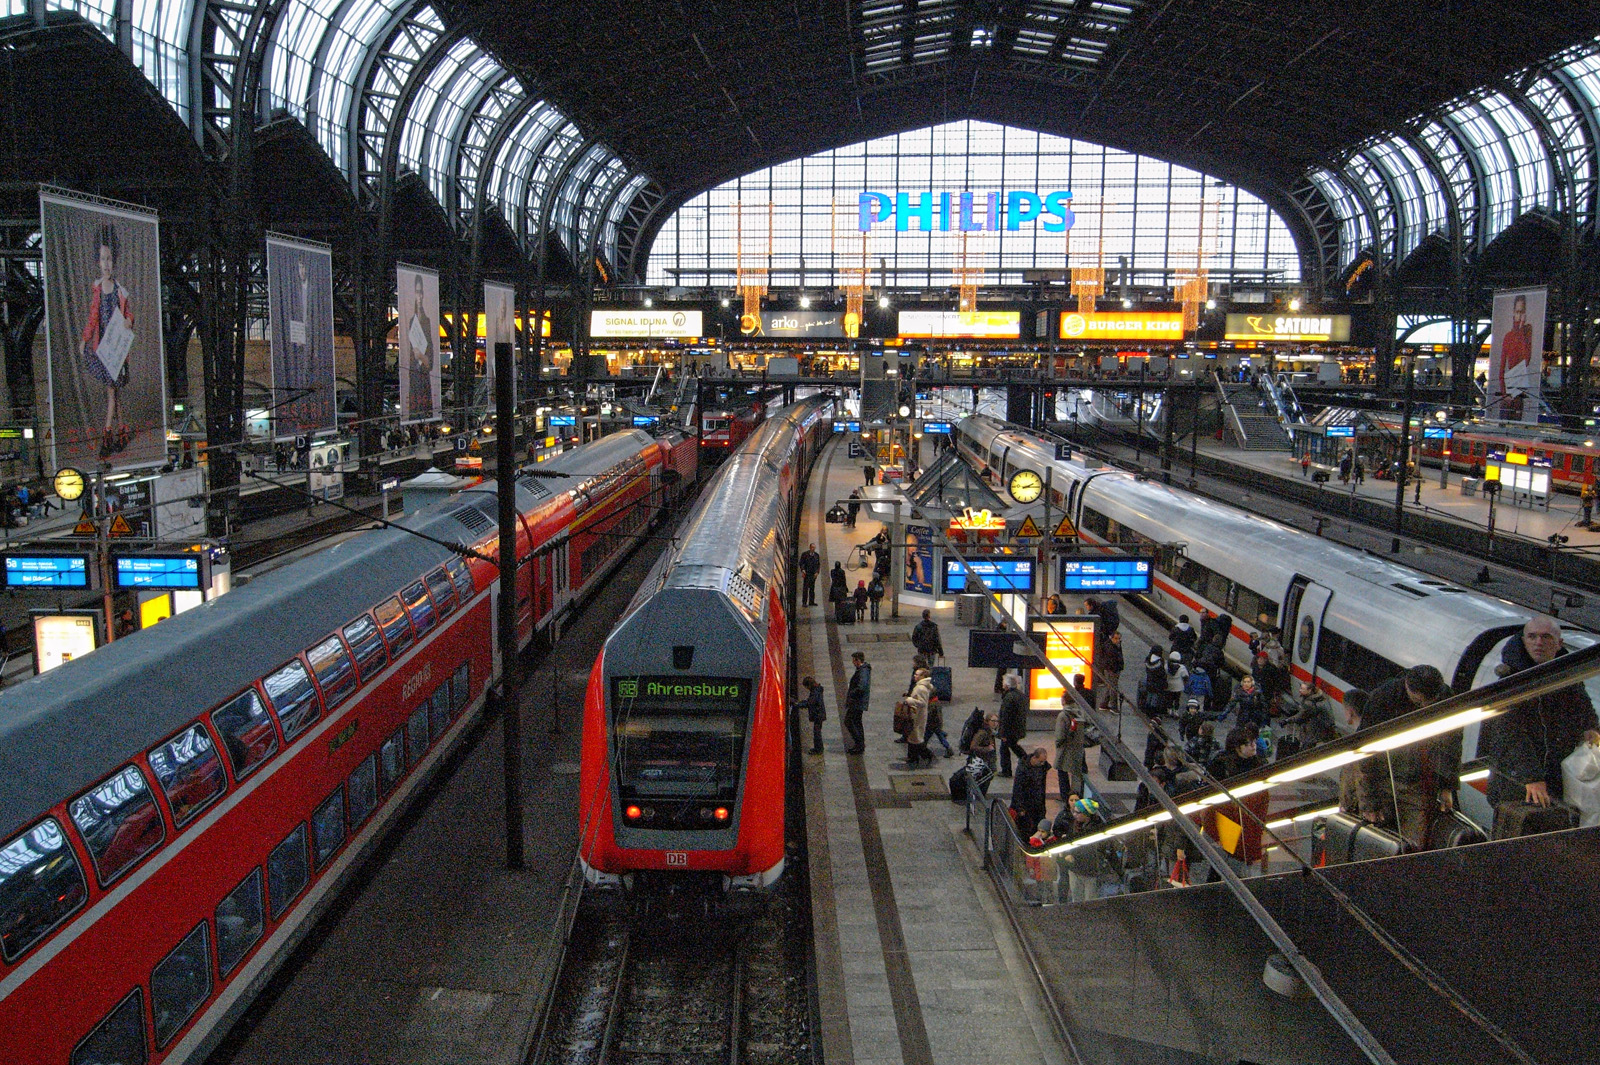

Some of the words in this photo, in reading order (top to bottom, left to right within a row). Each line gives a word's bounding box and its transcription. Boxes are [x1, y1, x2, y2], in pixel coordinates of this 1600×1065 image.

[858, 190, 1075, 232] PHILIPS
[605, 318, 638, 326] SIGNAL
[640, 318, 667, 326] IDUNA
[771, 315, 798, 329] arko
[1088, 320, 1142, 331] BURGER
[1146, 321, 1180, 331] KING
[1274, 317, 1332, 335] SATURN
[297, 437, 306, 449] D
[458, 438, 467, 450] D
[850, 443, 859, 456] E
[1062, 445, 1070, 458] E
[960, 519, 998, 528] KIOSK
[6, 556, 17, 568] 5a
[186, 559, 198, 569] 6a
[947, 561, 959, 571] 7a
[1136, 561, 1148, 572] 8a
[647, 682, 739, 698] Ahrensburg
[668, 853, 686, 864] DB
